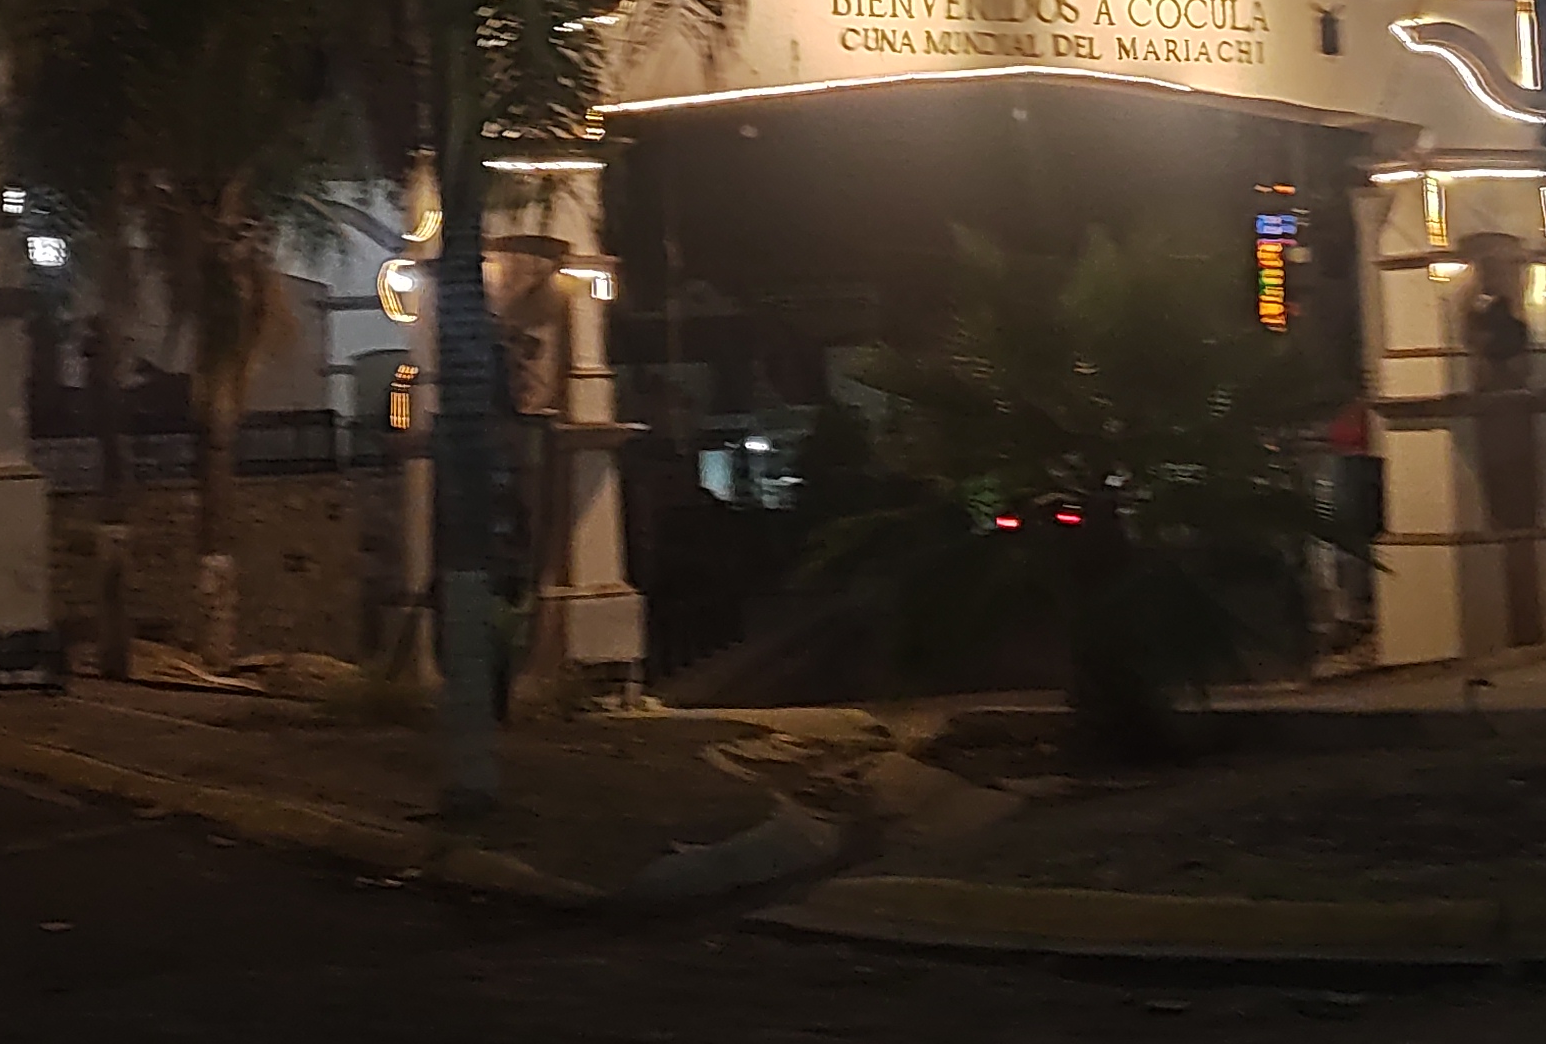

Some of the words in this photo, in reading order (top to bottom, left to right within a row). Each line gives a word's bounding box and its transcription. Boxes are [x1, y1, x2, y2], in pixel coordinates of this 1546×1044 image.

[840, 27, 916, 54] CUNA
[1052, 34, 1102, 60] DEL
[1116, 37, 1264, 64] MARIACHI
